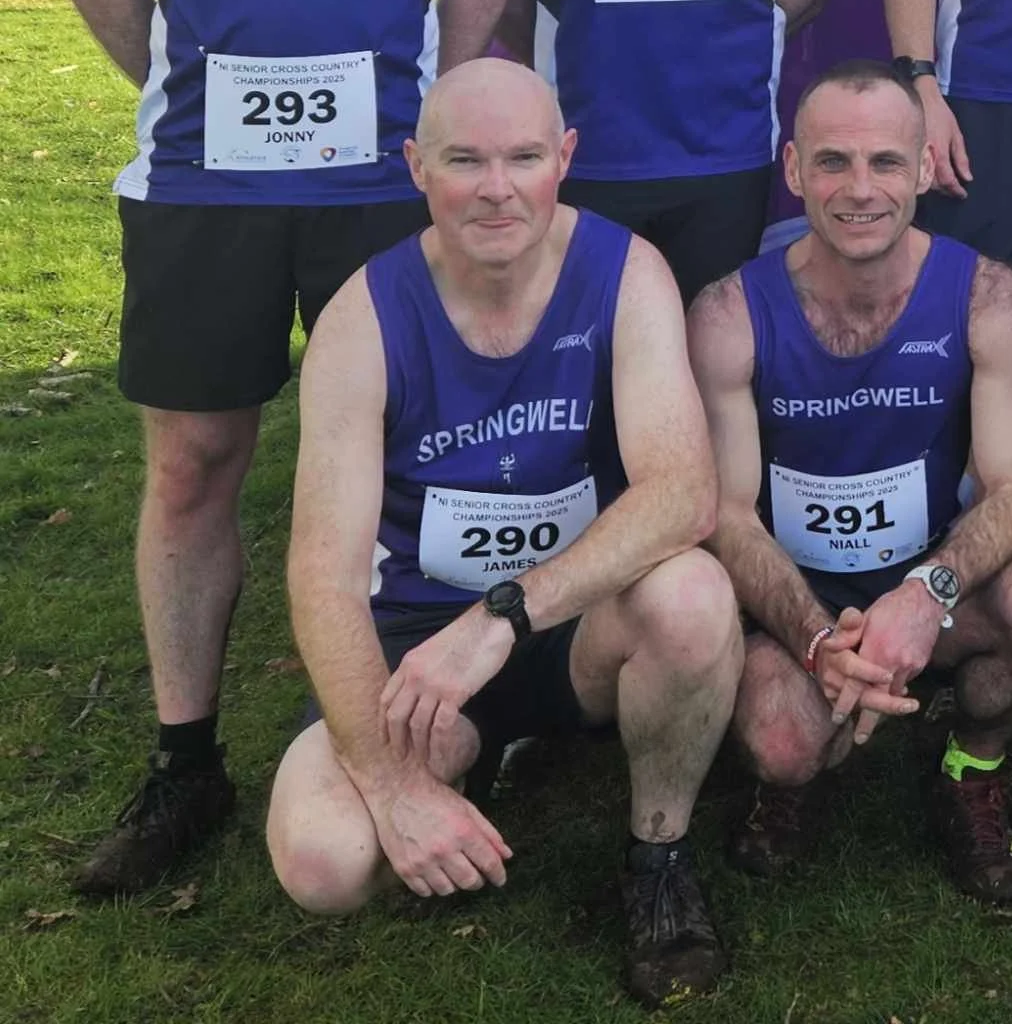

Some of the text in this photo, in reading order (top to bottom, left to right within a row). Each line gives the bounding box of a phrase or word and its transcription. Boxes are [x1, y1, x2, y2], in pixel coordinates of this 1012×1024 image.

[219, 61, 360, 74] NI SENIOR CROSS COUNTRY
[233, 75, 345, 85] CHAMPIONSHIPS 2025
[242, 89, 337, 125] 293
[265, 130, 316, 144] JONNY
[772, 386, 944, 418] SPRINGWELL
[792, 477, 826, 490] SENIOR
[828, 482, 864, 490] CROSS
[865, 471, 912, 486] COUNTRY
[439, 490, 584, 511] NI SENIOR CROSS COUNTRY
[795, 485, 898, 501] CHAMPIONSHIPS 2025
[453, 507, 569, 521] CHAMPIONSHIPS 2025
[805, 500, 895, 535] 291
[460, 522, 560, 558] 290
[829, 539, 871, 550] NIALL
[482, 557, 537, 573] JAMES
